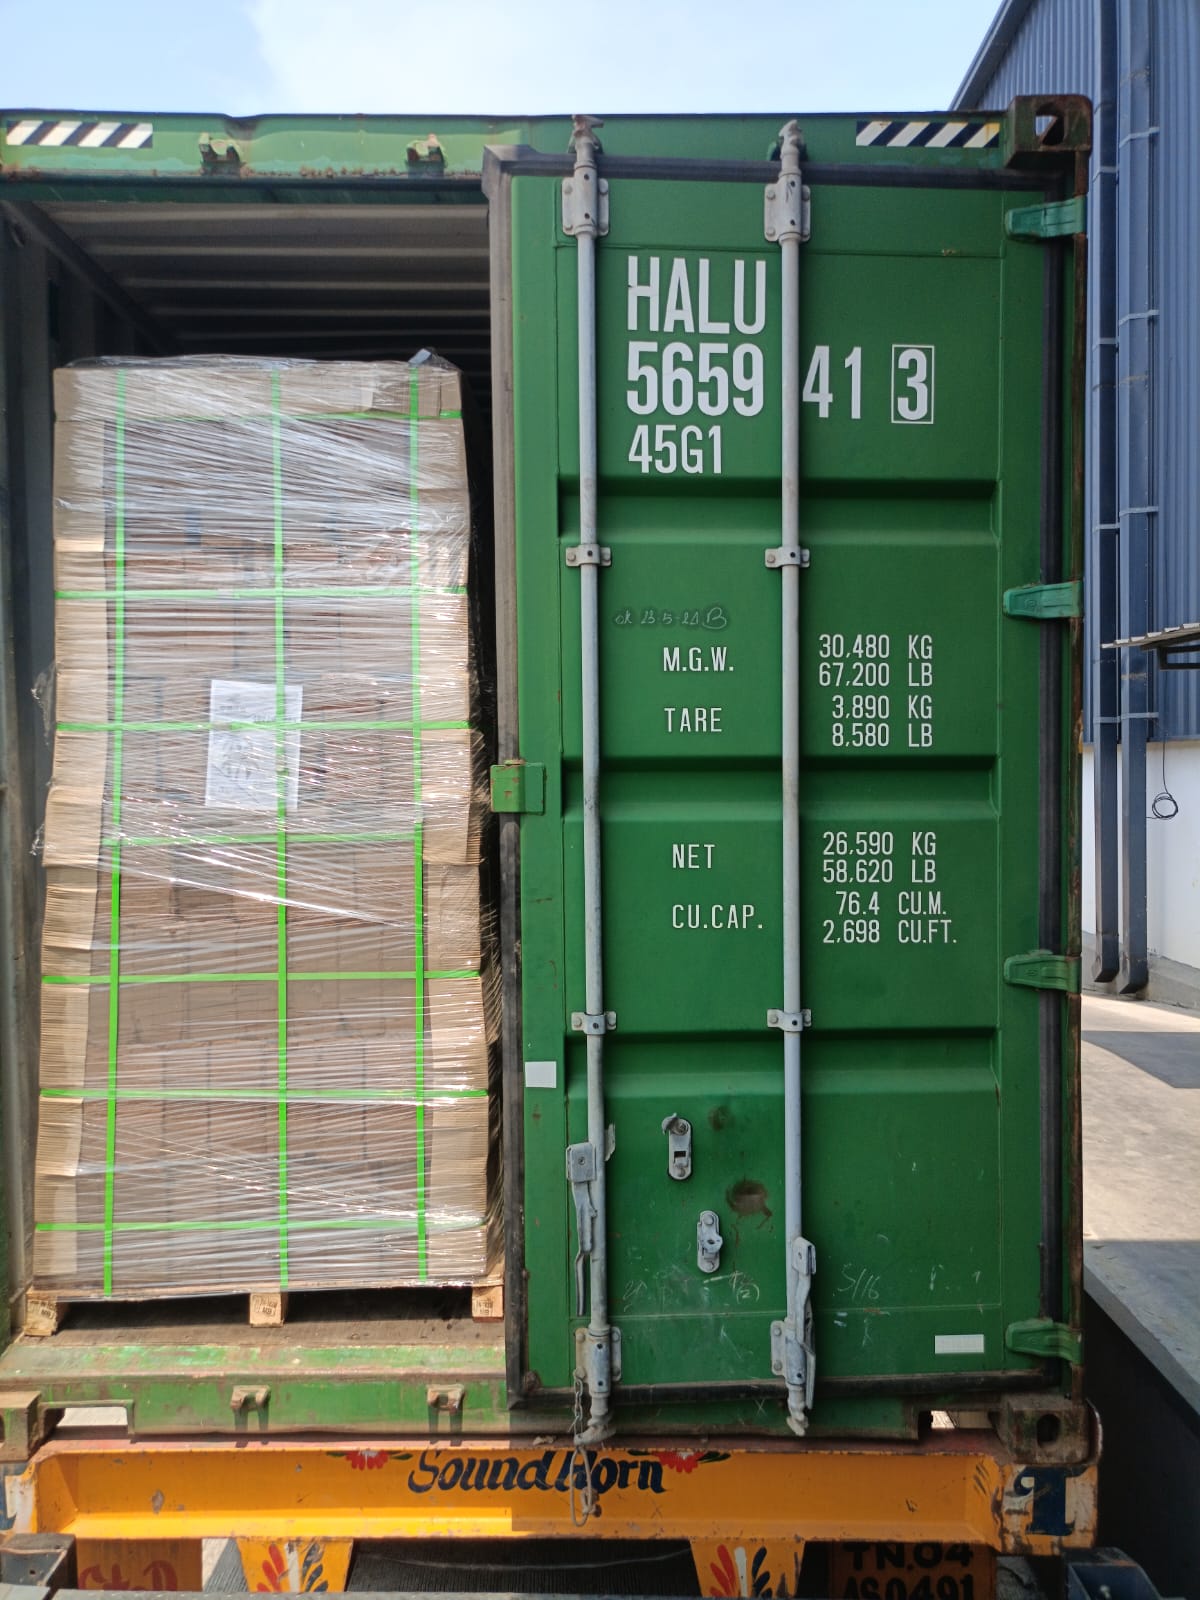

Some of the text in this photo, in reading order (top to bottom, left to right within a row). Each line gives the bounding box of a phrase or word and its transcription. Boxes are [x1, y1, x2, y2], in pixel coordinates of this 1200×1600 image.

[627, 255, 766, 335] HALU
[626, 341, 929, 421] 5659 41 3
[628, 424, 722, 474] 45G1
[663, 646, 734, 672] M.G.W.
[819, 633, 933, 660] 30,480 KG
[819, 661, 933, 688] 67,200 LB
[664, 707, 722, 732] TARE
[832, 694, 933, 720] 3,890 KG
[832, 722, 933, 748] 8,580 LB
[672, 843, 716, 869] NET
[822, 831, 936, 857] 26,590 KG
[822, 859, 936, 884] 58,620 LB
[835, 890, 947, 916] 76.4 CU.M.
[672, 903, 763, 930] CU.CAP.
[822, 919, 957, 944] 2,698 CU.FT.
[408, 1450, 667, 1494] Sound Horn
